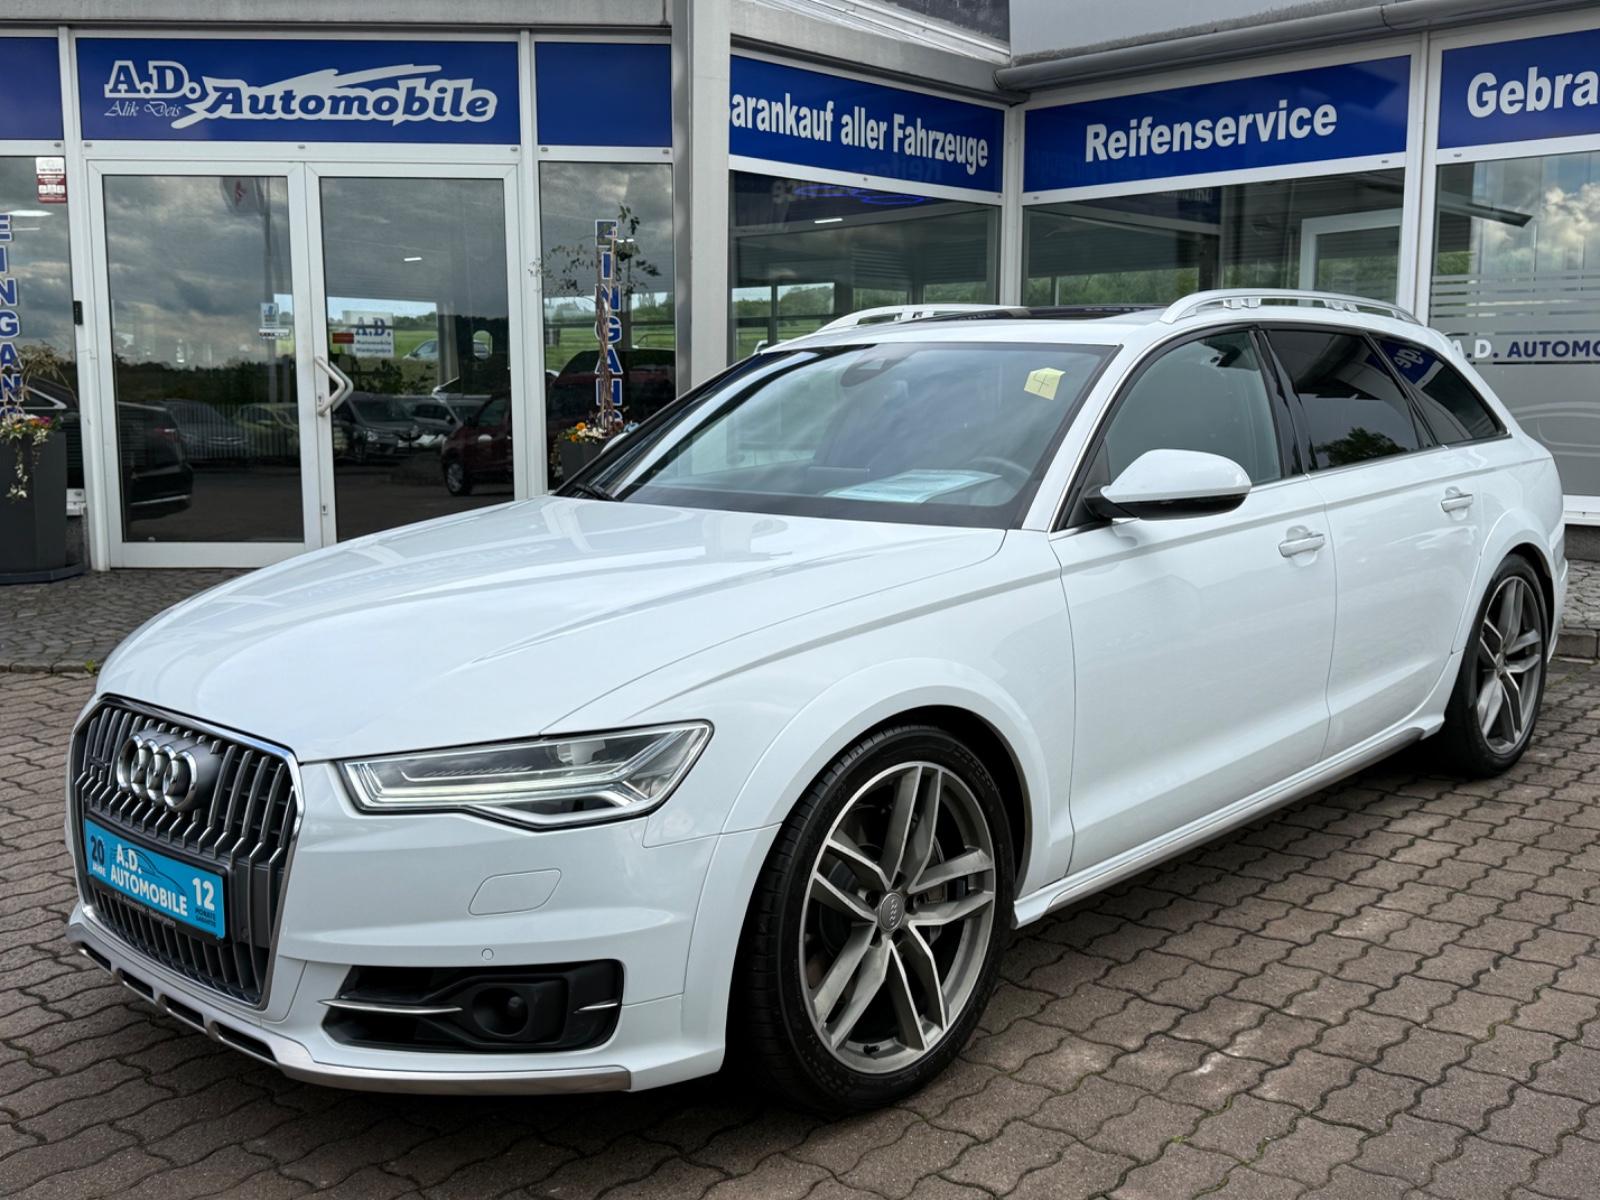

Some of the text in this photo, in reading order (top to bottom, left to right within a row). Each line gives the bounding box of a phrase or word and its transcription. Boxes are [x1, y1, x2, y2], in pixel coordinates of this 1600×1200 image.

[104, 60, 498, 124] A.D. Automobile
[104, 101, 139, 117] Alik
[1467, 66, 1599, 118] Gebra
[730, 93, 834, 142] arankauf
[841, 106, 887, 150] aller
[893, 113, 988, 175] Fahrzeuge
[1085, 99, 1338, 162] Reifenservice
[355, 316, 391, 336] A.D.
[90, 835, 105, 866] 20
[116, 843, 142, 875] A.D.
[111, 864, 188, 917] AUTOMOBILE
[192, 877, 215, 912] 12
